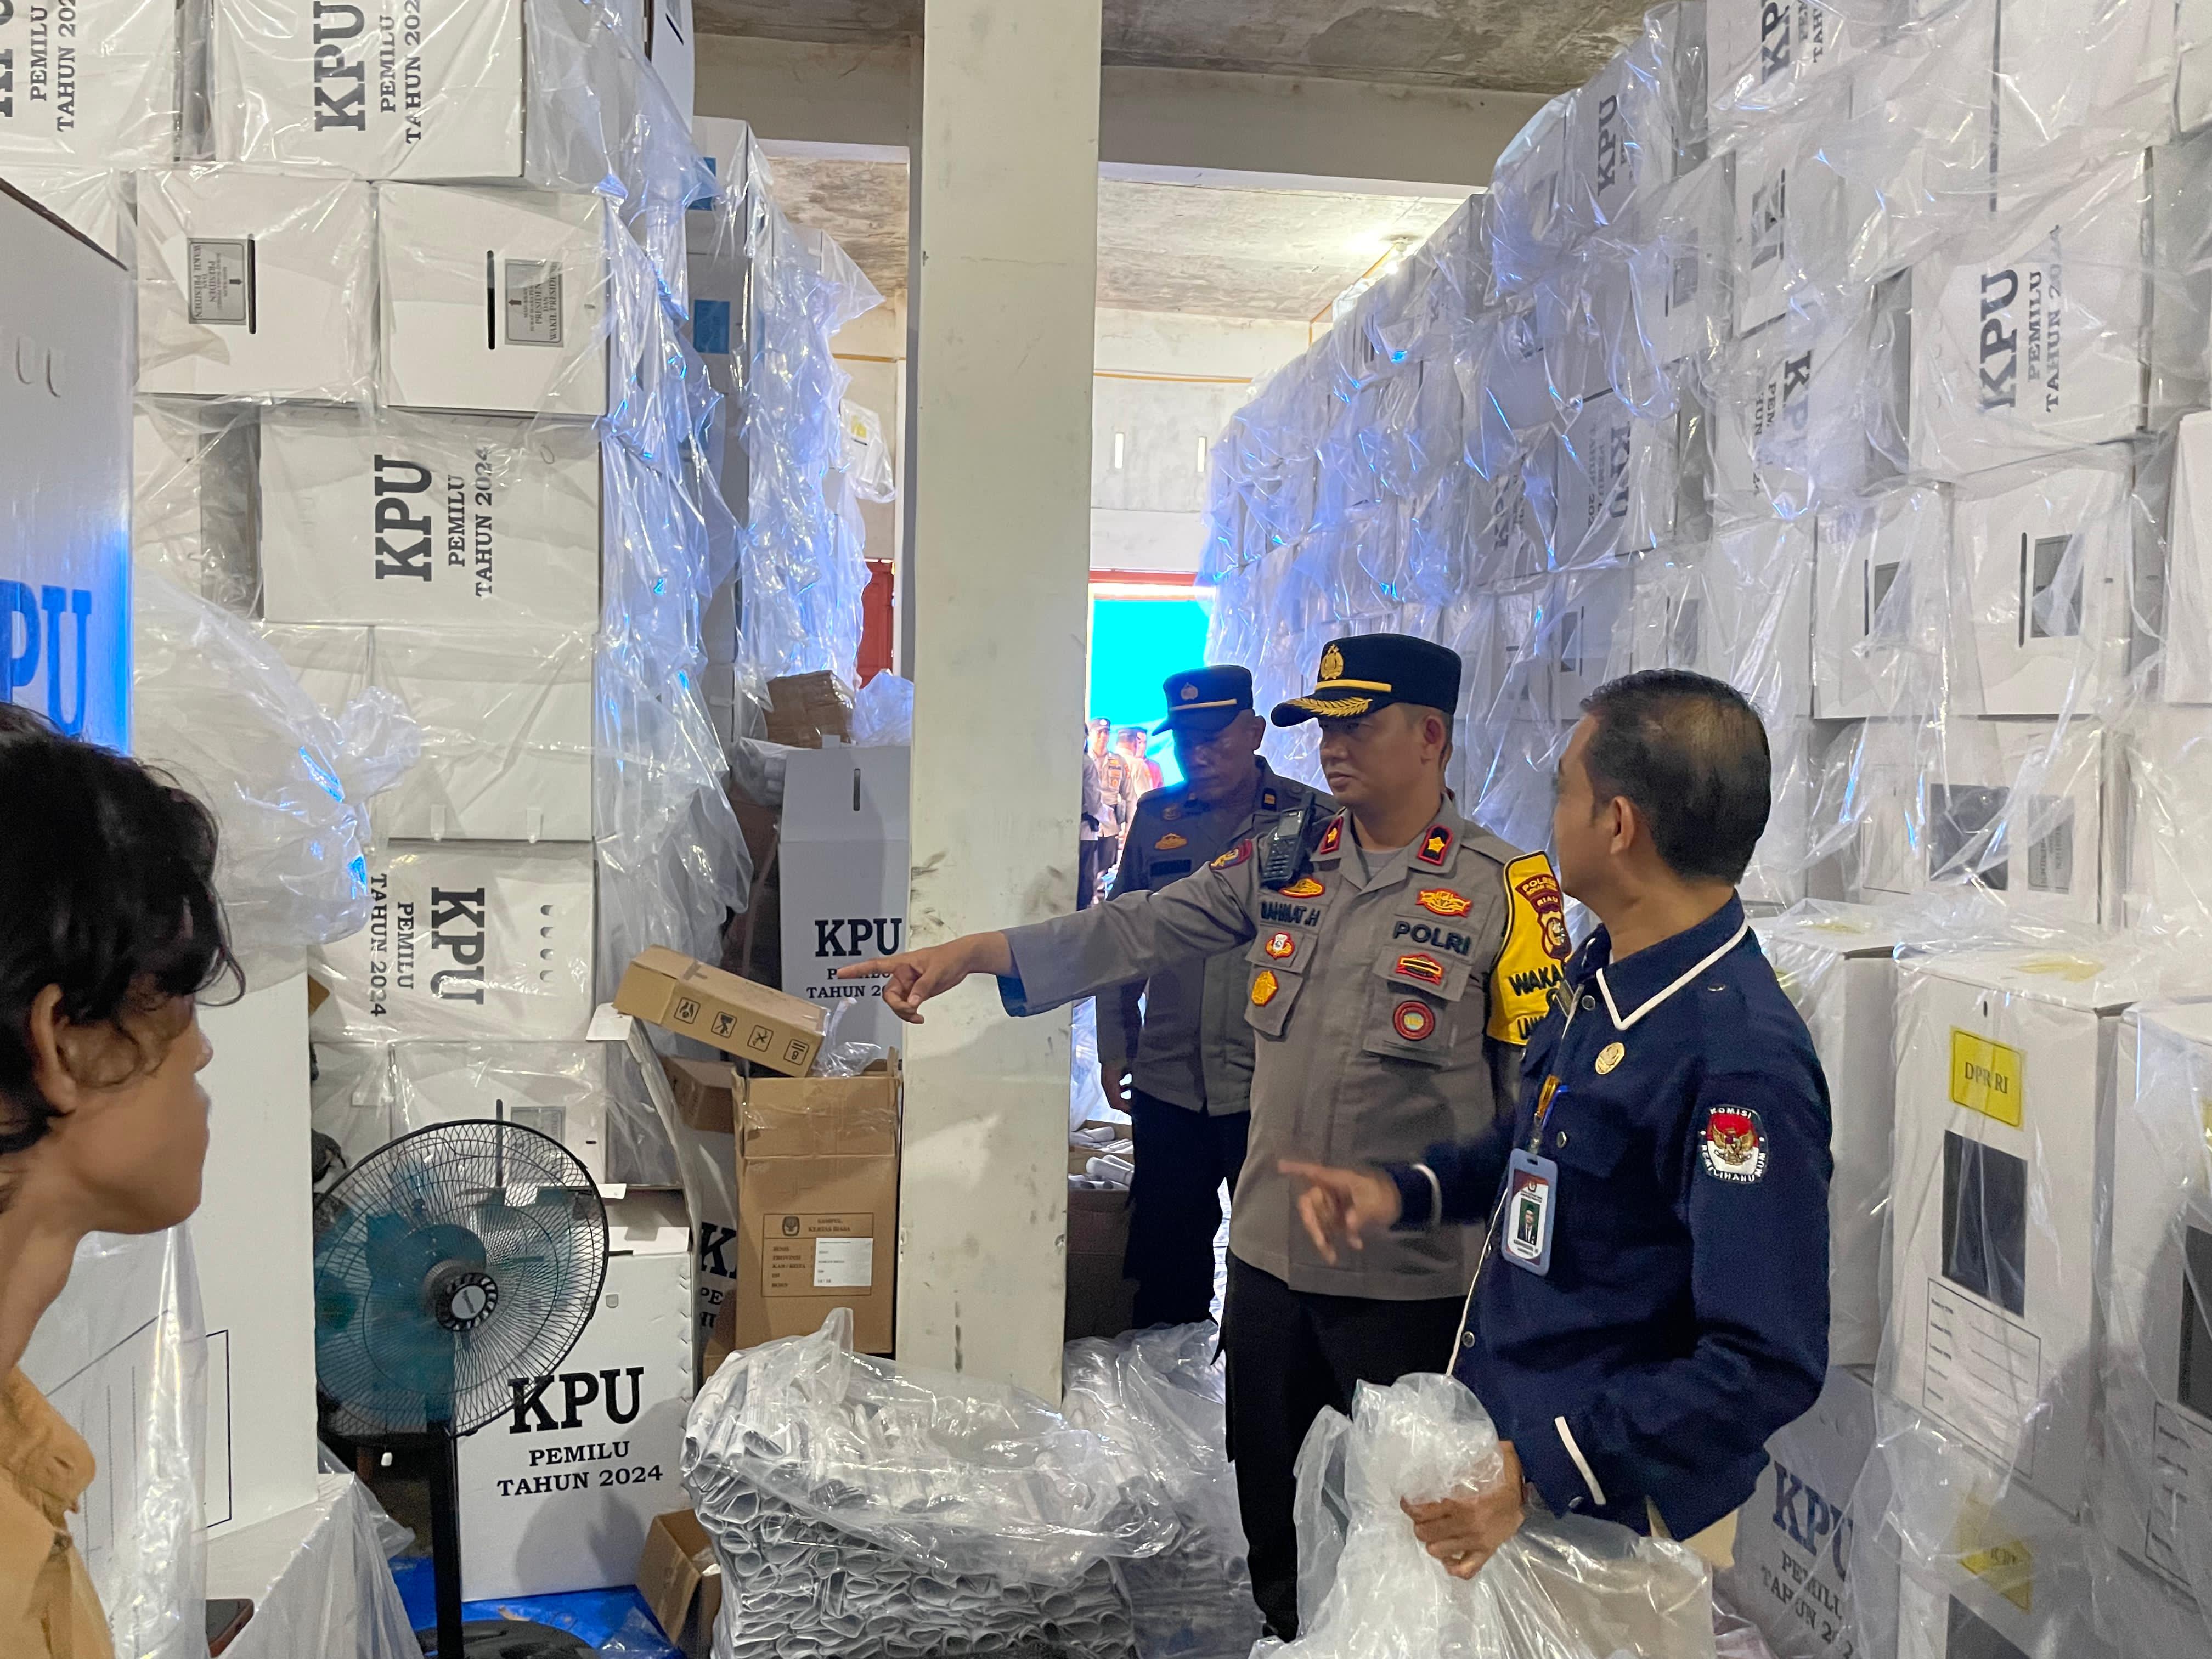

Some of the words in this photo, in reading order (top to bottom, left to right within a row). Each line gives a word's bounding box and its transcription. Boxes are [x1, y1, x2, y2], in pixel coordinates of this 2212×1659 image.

[30, 5, 48, 101] PEMILU
[313, 1, 366, 132] KPU
[380, 15, 396, 113] PEMILU
[1762, 0, 1790, 84] KP
[57, 46, 75, 132] TAHUN
[405, 57, 421, 144] TAHUN
[1598, 95, 1617, 197] KPU
[194, 275, 202, 317] PRESIDEN
[208, 261, 216, 302] PRESIDEN
[1979, 269, 2018, 409] KPU
[2028, 272, 2041, 381] PEMILU
[2046, 309, 2061, 413] TAHUN
[374, 454, 432, 582] KPU
[448, 475, 465, 567] PEMILU
[475, 514, 492, 597] TAHUN
[371, 873, 387, 952] TAHUN
[815, 918, 902, 957] KPU
[1393, 921, 1471, 956] POLRI
[1537, 896, 1558, 906] RIAU
[397, 902, 414, 989] PEMILU
[431, 887, 485, 1005] KPU
[370, 961, 387, 1017] 2024
[806, 985, 866, 998] TAHUN
[1709, 1107, 1752, 1119] KOMISI
[1965, 1062, 1991, 1088] DPR
[1995, 1072, 2008, 1094] RI
[507, 1367, 644, 1434] KPU
[497, 1472, 589, 1496] TAHUN
[599, 1465, 663, 1487] 2024
[529, 1441, 630, 1466] PEMILU
